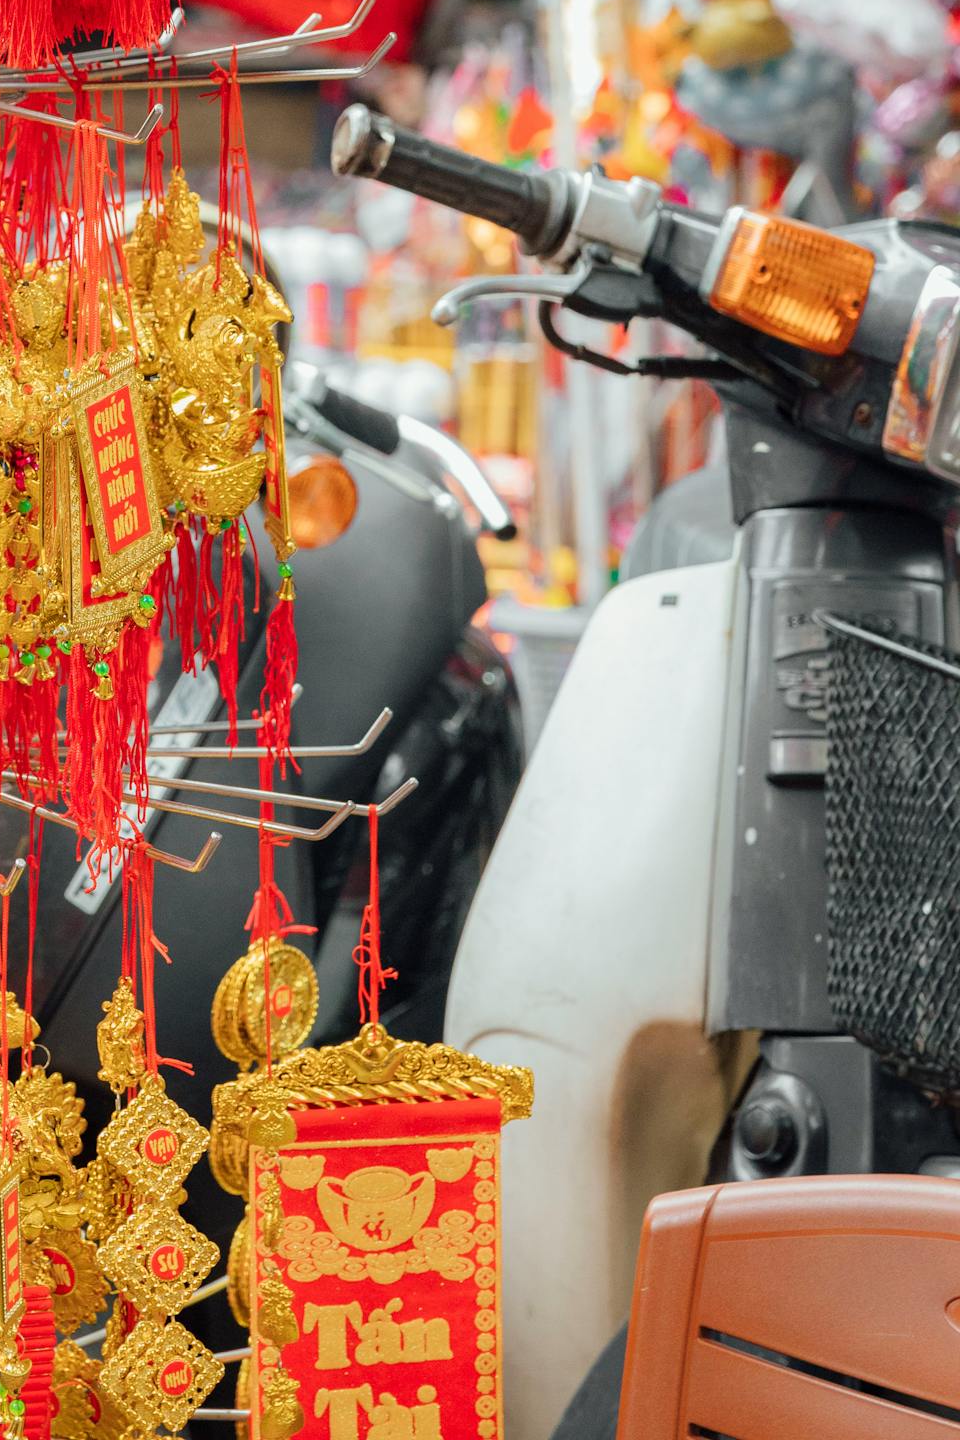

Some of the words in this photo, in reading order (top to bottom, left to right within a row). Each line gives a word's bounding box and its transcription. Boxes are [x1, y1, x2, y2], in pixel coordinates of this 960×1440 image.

[93, 395, 126, 438] CHÚC
[98, 433, 134, 474] MỪNG
[107, 468, 136, 507] NĂM
[113, 501, 138, 542] MỚI
[149, 1135, 175, 1161] VẠN
[157, 1247, 179, 1276] SỰ
[303, 1297, 454, 1370] Tấn
[314, 1383, 444, 1440] Tài
